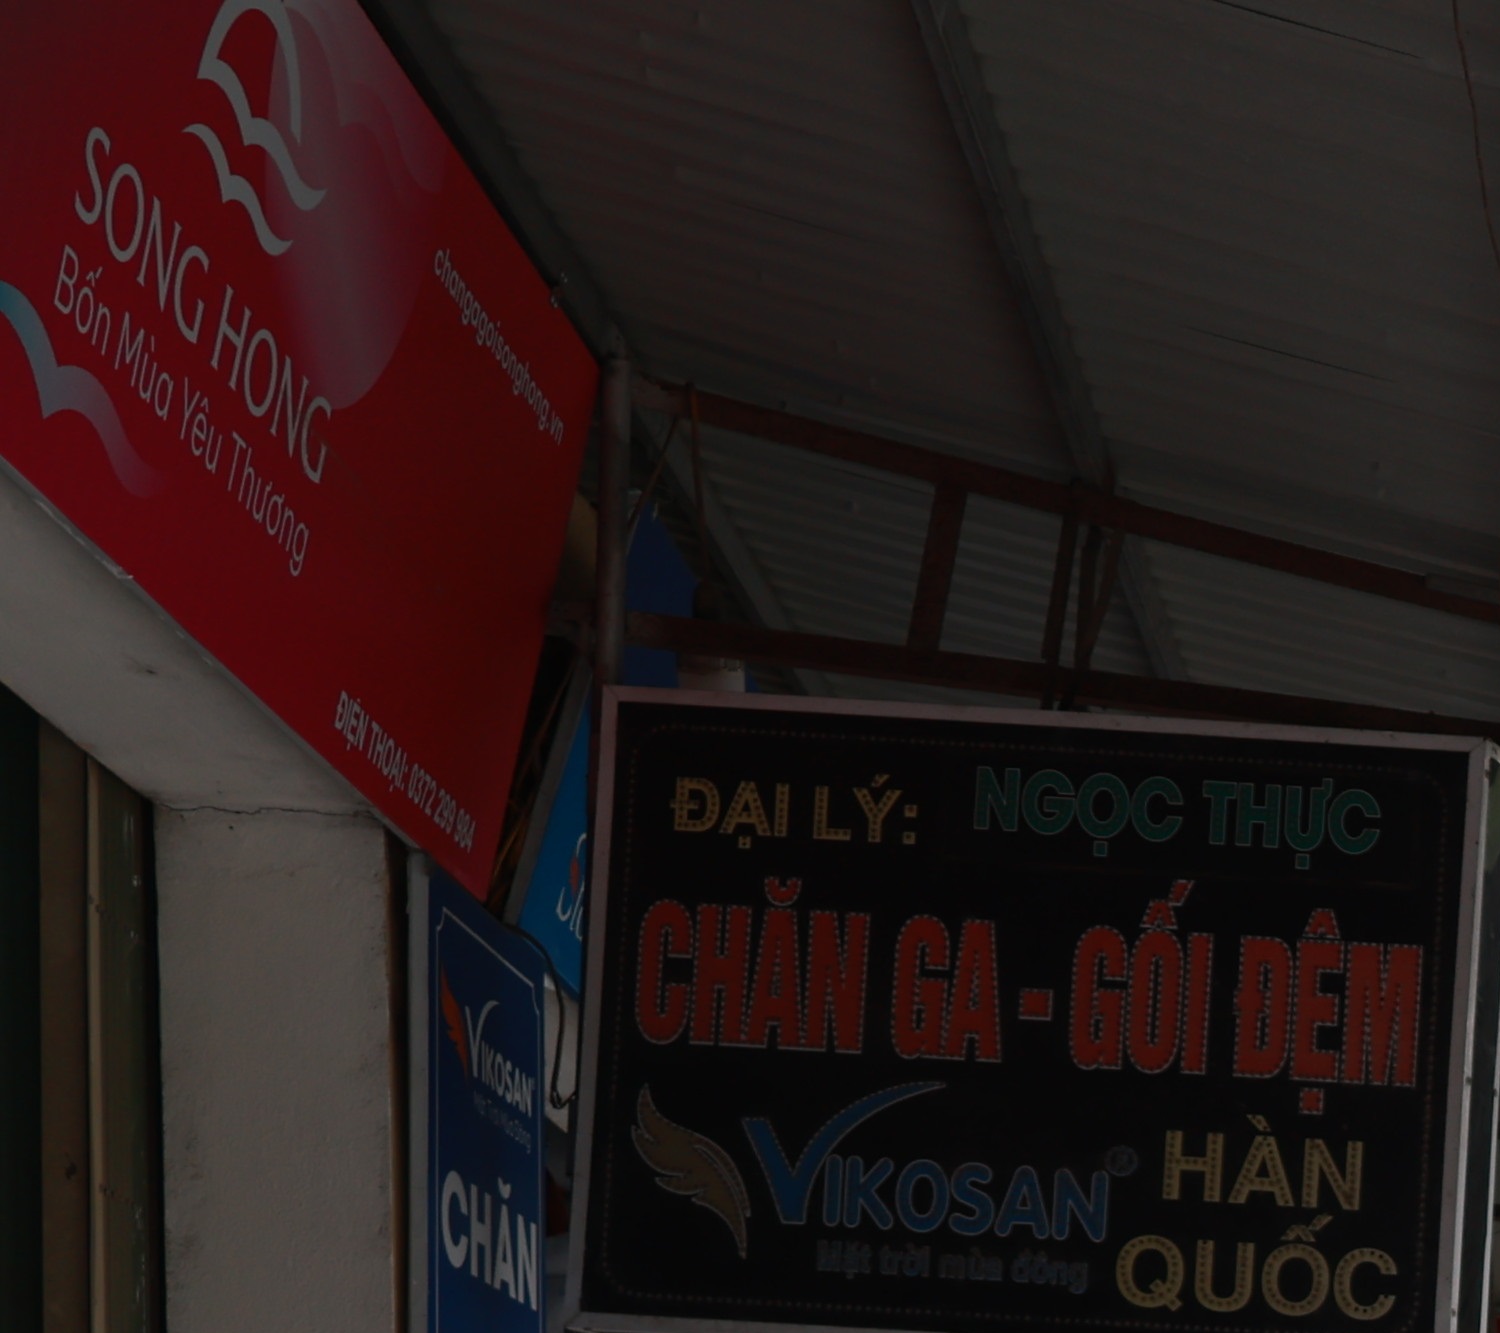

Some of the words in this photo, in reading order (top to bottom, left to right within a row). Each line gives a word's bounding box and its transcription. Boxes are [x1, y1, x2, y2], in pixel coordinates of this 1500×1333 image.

[75, 127, 210, 343] SONG
[213, 285, 332, 484] HONG
[434, 248, 564, 446] changagoisonghong.vn
[55, 246, 110, 356] Bốn
[115, 320, 174, 422] Mùa
[181, 378, 219, 473] Yêu
[227, 430, 309, 576] Thương
[334, 690, 369, 751] ĐIỆN
[669, 776, 790, 849] ĐẠI
[812, 773, 918, 845] LÝ:
[973, 766, 1184, 857] NGỌC
[1202, 778, 1381, 870] THỰC
[633, 877, 871, 1054] CHĂN
[890, 914, 1001, 1063] GA
[1068, 879, 1214, 1075] GỐI
[1232, 907, 1424, 1115] ĐỆM
[1162, 1114, 1364, 1212] HÀN
[441, 1170, 538, 1312] CHĂN
[1115, 1215, 1398, 1321] QUỐC
